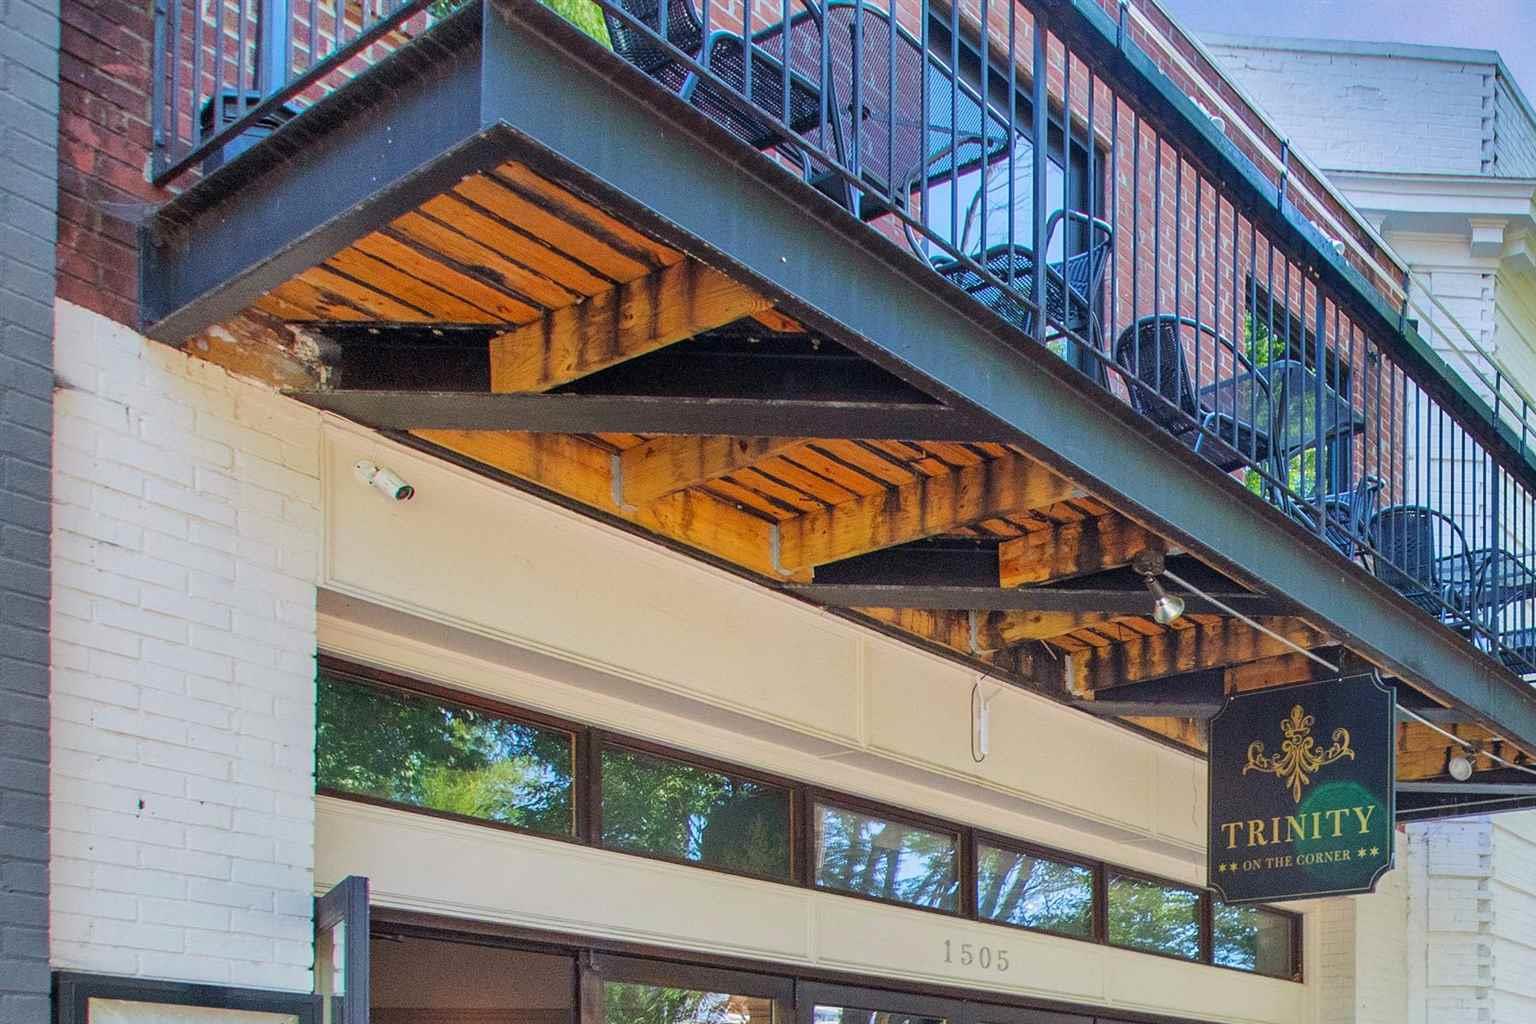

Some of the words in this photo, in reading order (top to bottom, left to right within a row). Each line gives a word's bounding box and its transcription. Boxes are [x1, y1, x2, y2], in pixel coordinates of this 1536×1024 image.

[1221, 805, 1377, 849] TRINITY
[1243, 858, 1262, 872] ON
[1265, 855, 1293, 869] THE
[1296, 849, 1351, 866] CORNER
[944, 939, 1010, 972] 1505
